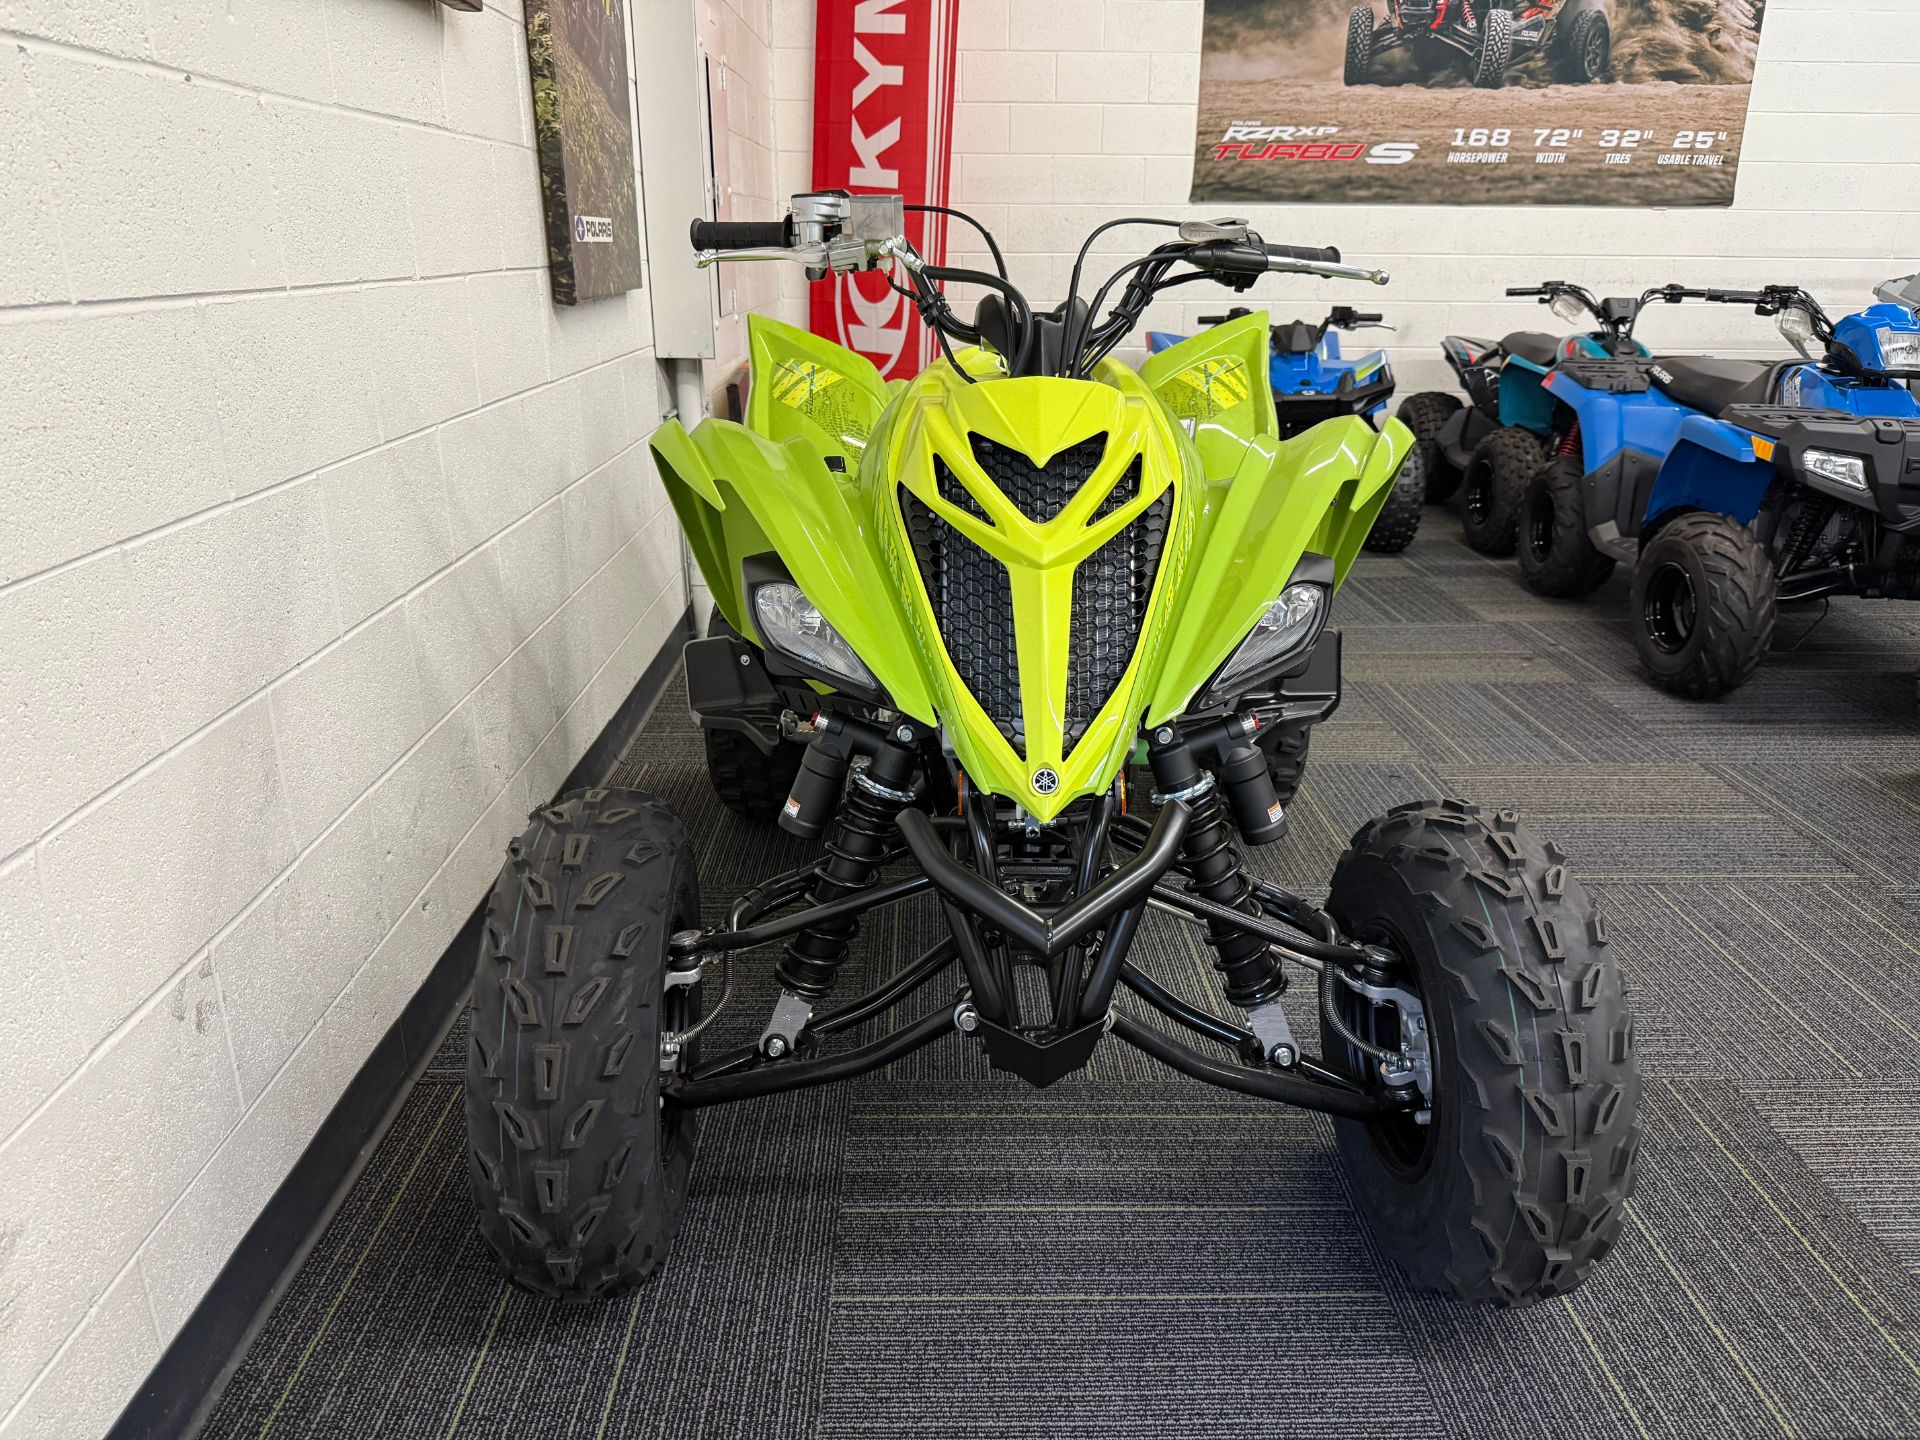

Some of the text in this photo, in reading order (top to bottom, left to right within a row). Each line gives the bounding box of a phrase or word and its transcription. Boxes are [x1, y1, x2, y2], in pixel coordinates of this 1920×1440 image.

[1450, 127, 1512, 147] 168
[1532, 128, 1584, 148] 72"
[1598, 129, 1654, 149] 32"
[1672, 130, 1728, 149] 25"
[1210, 142, 1421, 165] TURBO S
[1446, 151, 1508, 164] HORSEPOWER
[1535, 152, 1566, 164] WIDTH
[1604, 152, 1632, 165] TIRES
[1657, 153, 1725, 167] USABLE TRAVEL
[585, 220, 612, 238] POLARIS
